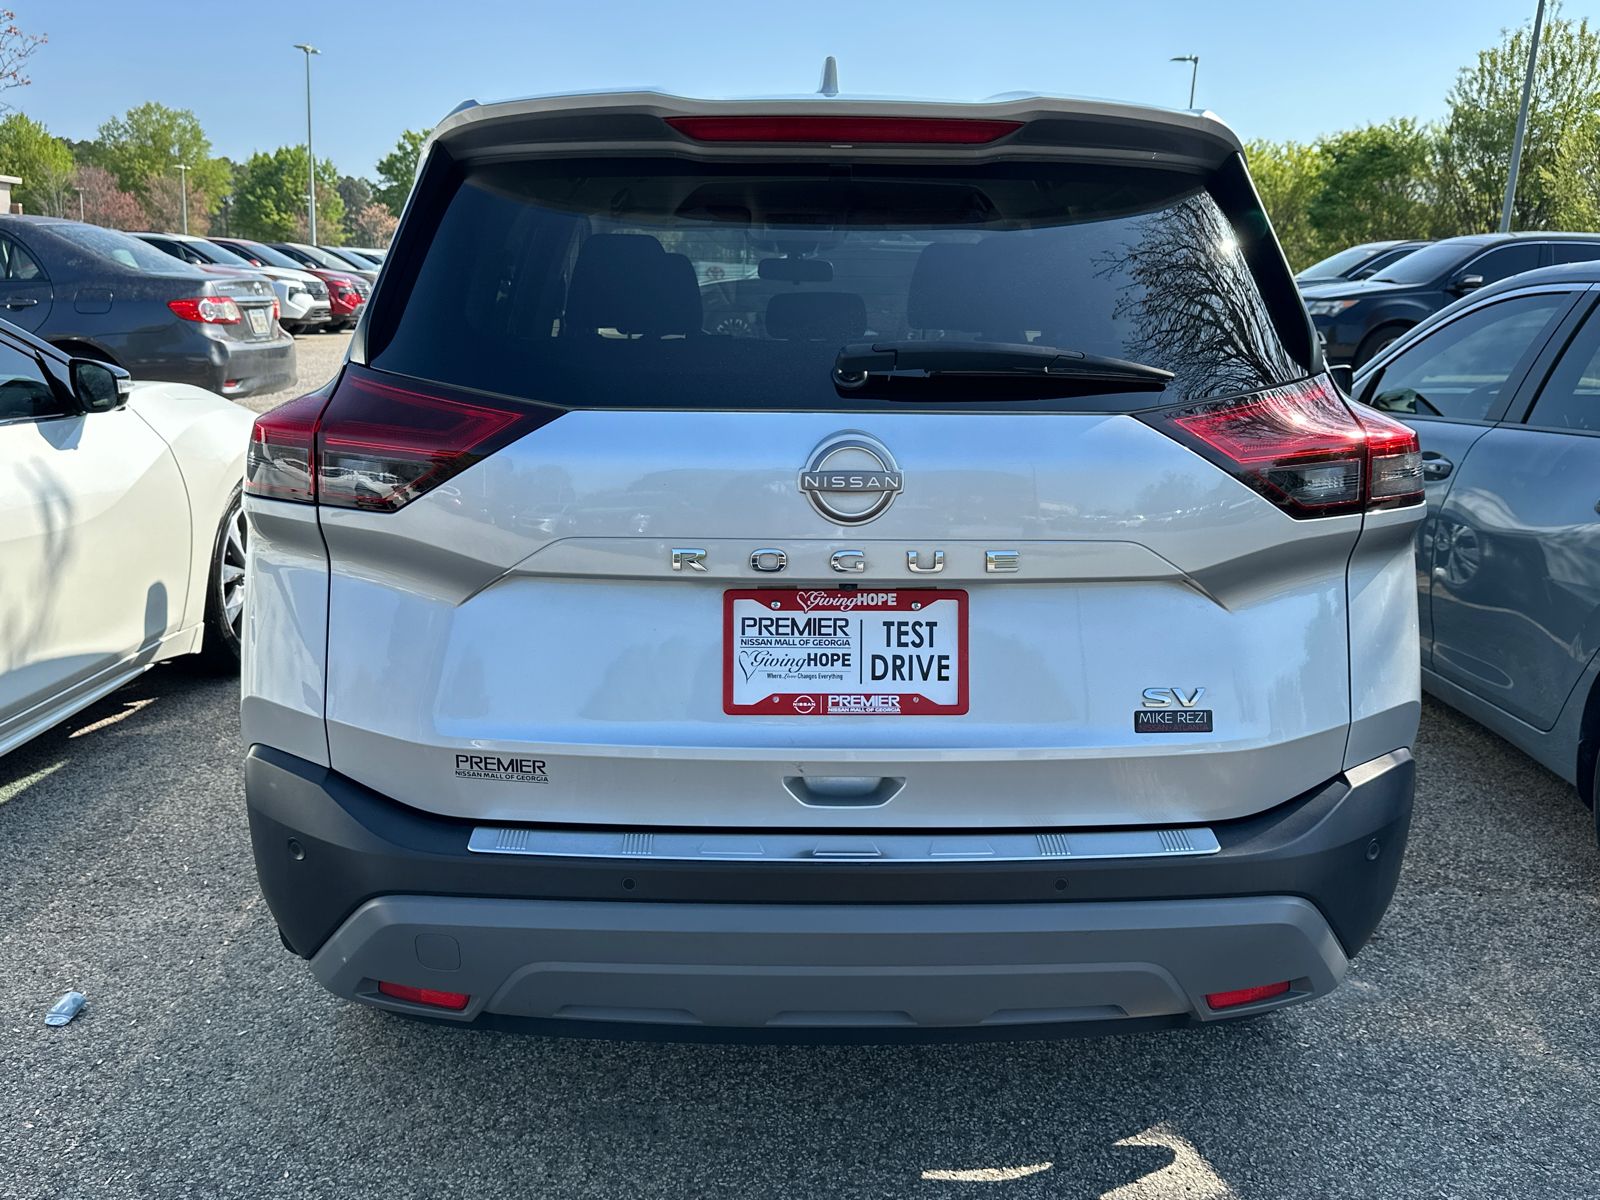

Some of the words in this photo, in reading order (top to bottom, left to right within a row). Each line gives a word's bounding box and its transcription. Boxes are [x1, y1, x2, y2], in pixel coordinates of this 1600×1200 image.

[804, 475, 900, 489] NISSAN
[671, 547, 1020, 574] ROGUE
[741, 617, 850, 636] PREMIER
[882, 621, 938, 648] TEST
[740, 638, 773, 646] NISSAN
[812, 639, 851, 647] GEORGIA
[870, 655, 950, 681] DRIVE
[828, 695, 900, 707] PREMIER
[1142, 687, 1206, 708] SV
[1139, 712, 1173, 724] MIKE
[1177, 712, 1207, 723] REZI
[455, 754, 547, 775] PREMIER
[455, 770, 482, 778] NISSAN
[516, 774, 549, 782] GEORGIA
